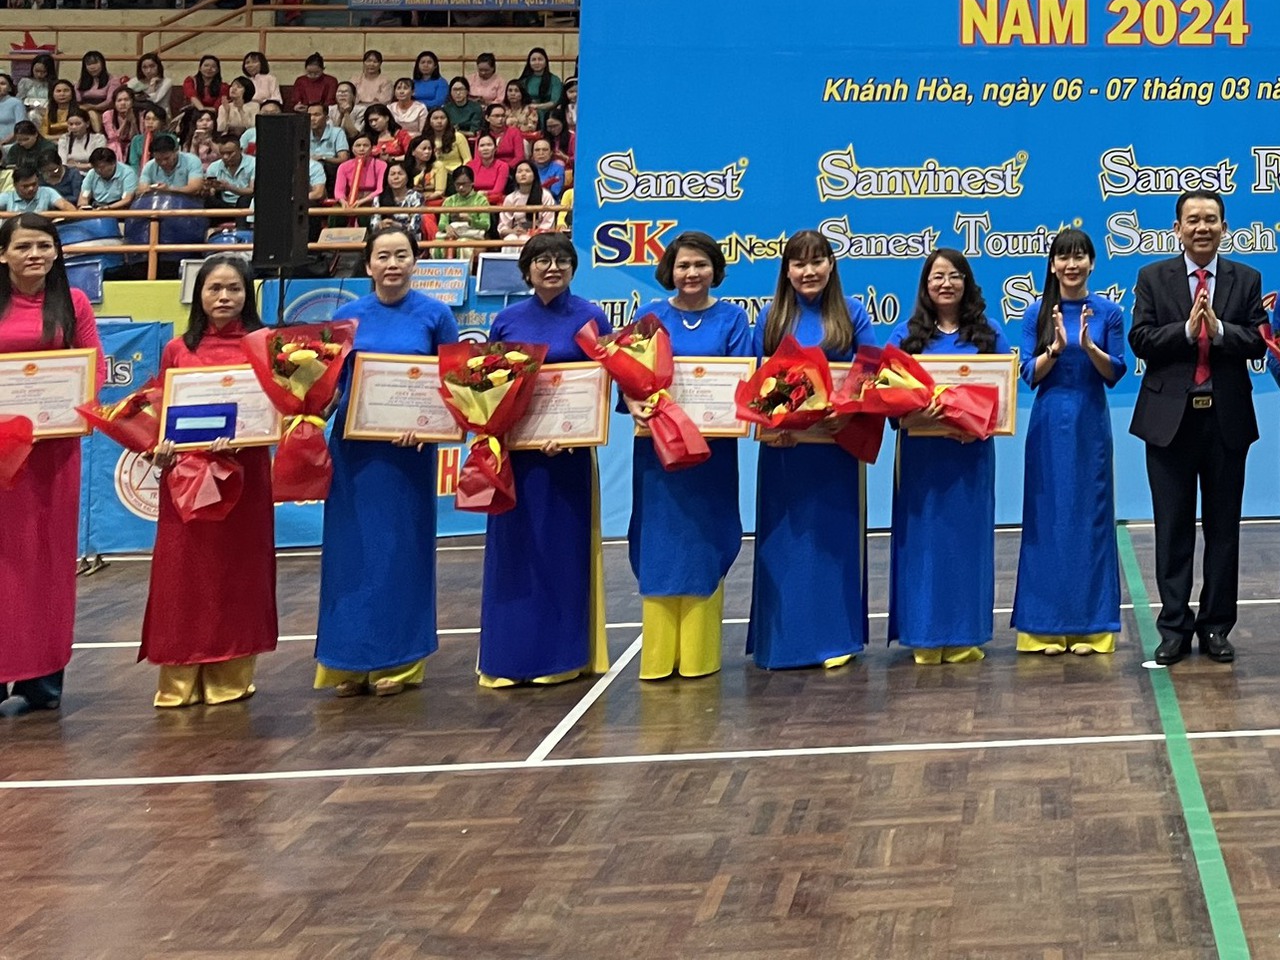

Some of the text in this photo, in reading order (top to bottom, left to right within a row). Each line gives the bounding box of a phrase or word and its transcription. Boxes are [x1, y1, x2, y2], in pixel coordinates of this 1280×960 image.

[822, 77, 909, 103] Khánh
[915, 78, 974, 106] Hòa,
[981, 78, 1048, 107] ngày
[1051, 78, 1083, 102] 06
[1105, 78, 1138, 102] 07
[1143, 76, 1214, 106] tháng
[1220, 77, 1250, 102] 03
[594, 147, 748, 208] Sanest
[817, 143, 1027, 203] Sanvinest
[1099, 144, 1239, 200] Sanest
[817, 211, 1071, 261] Sanest Touris
[851, 285, 900, 326] ÀO
